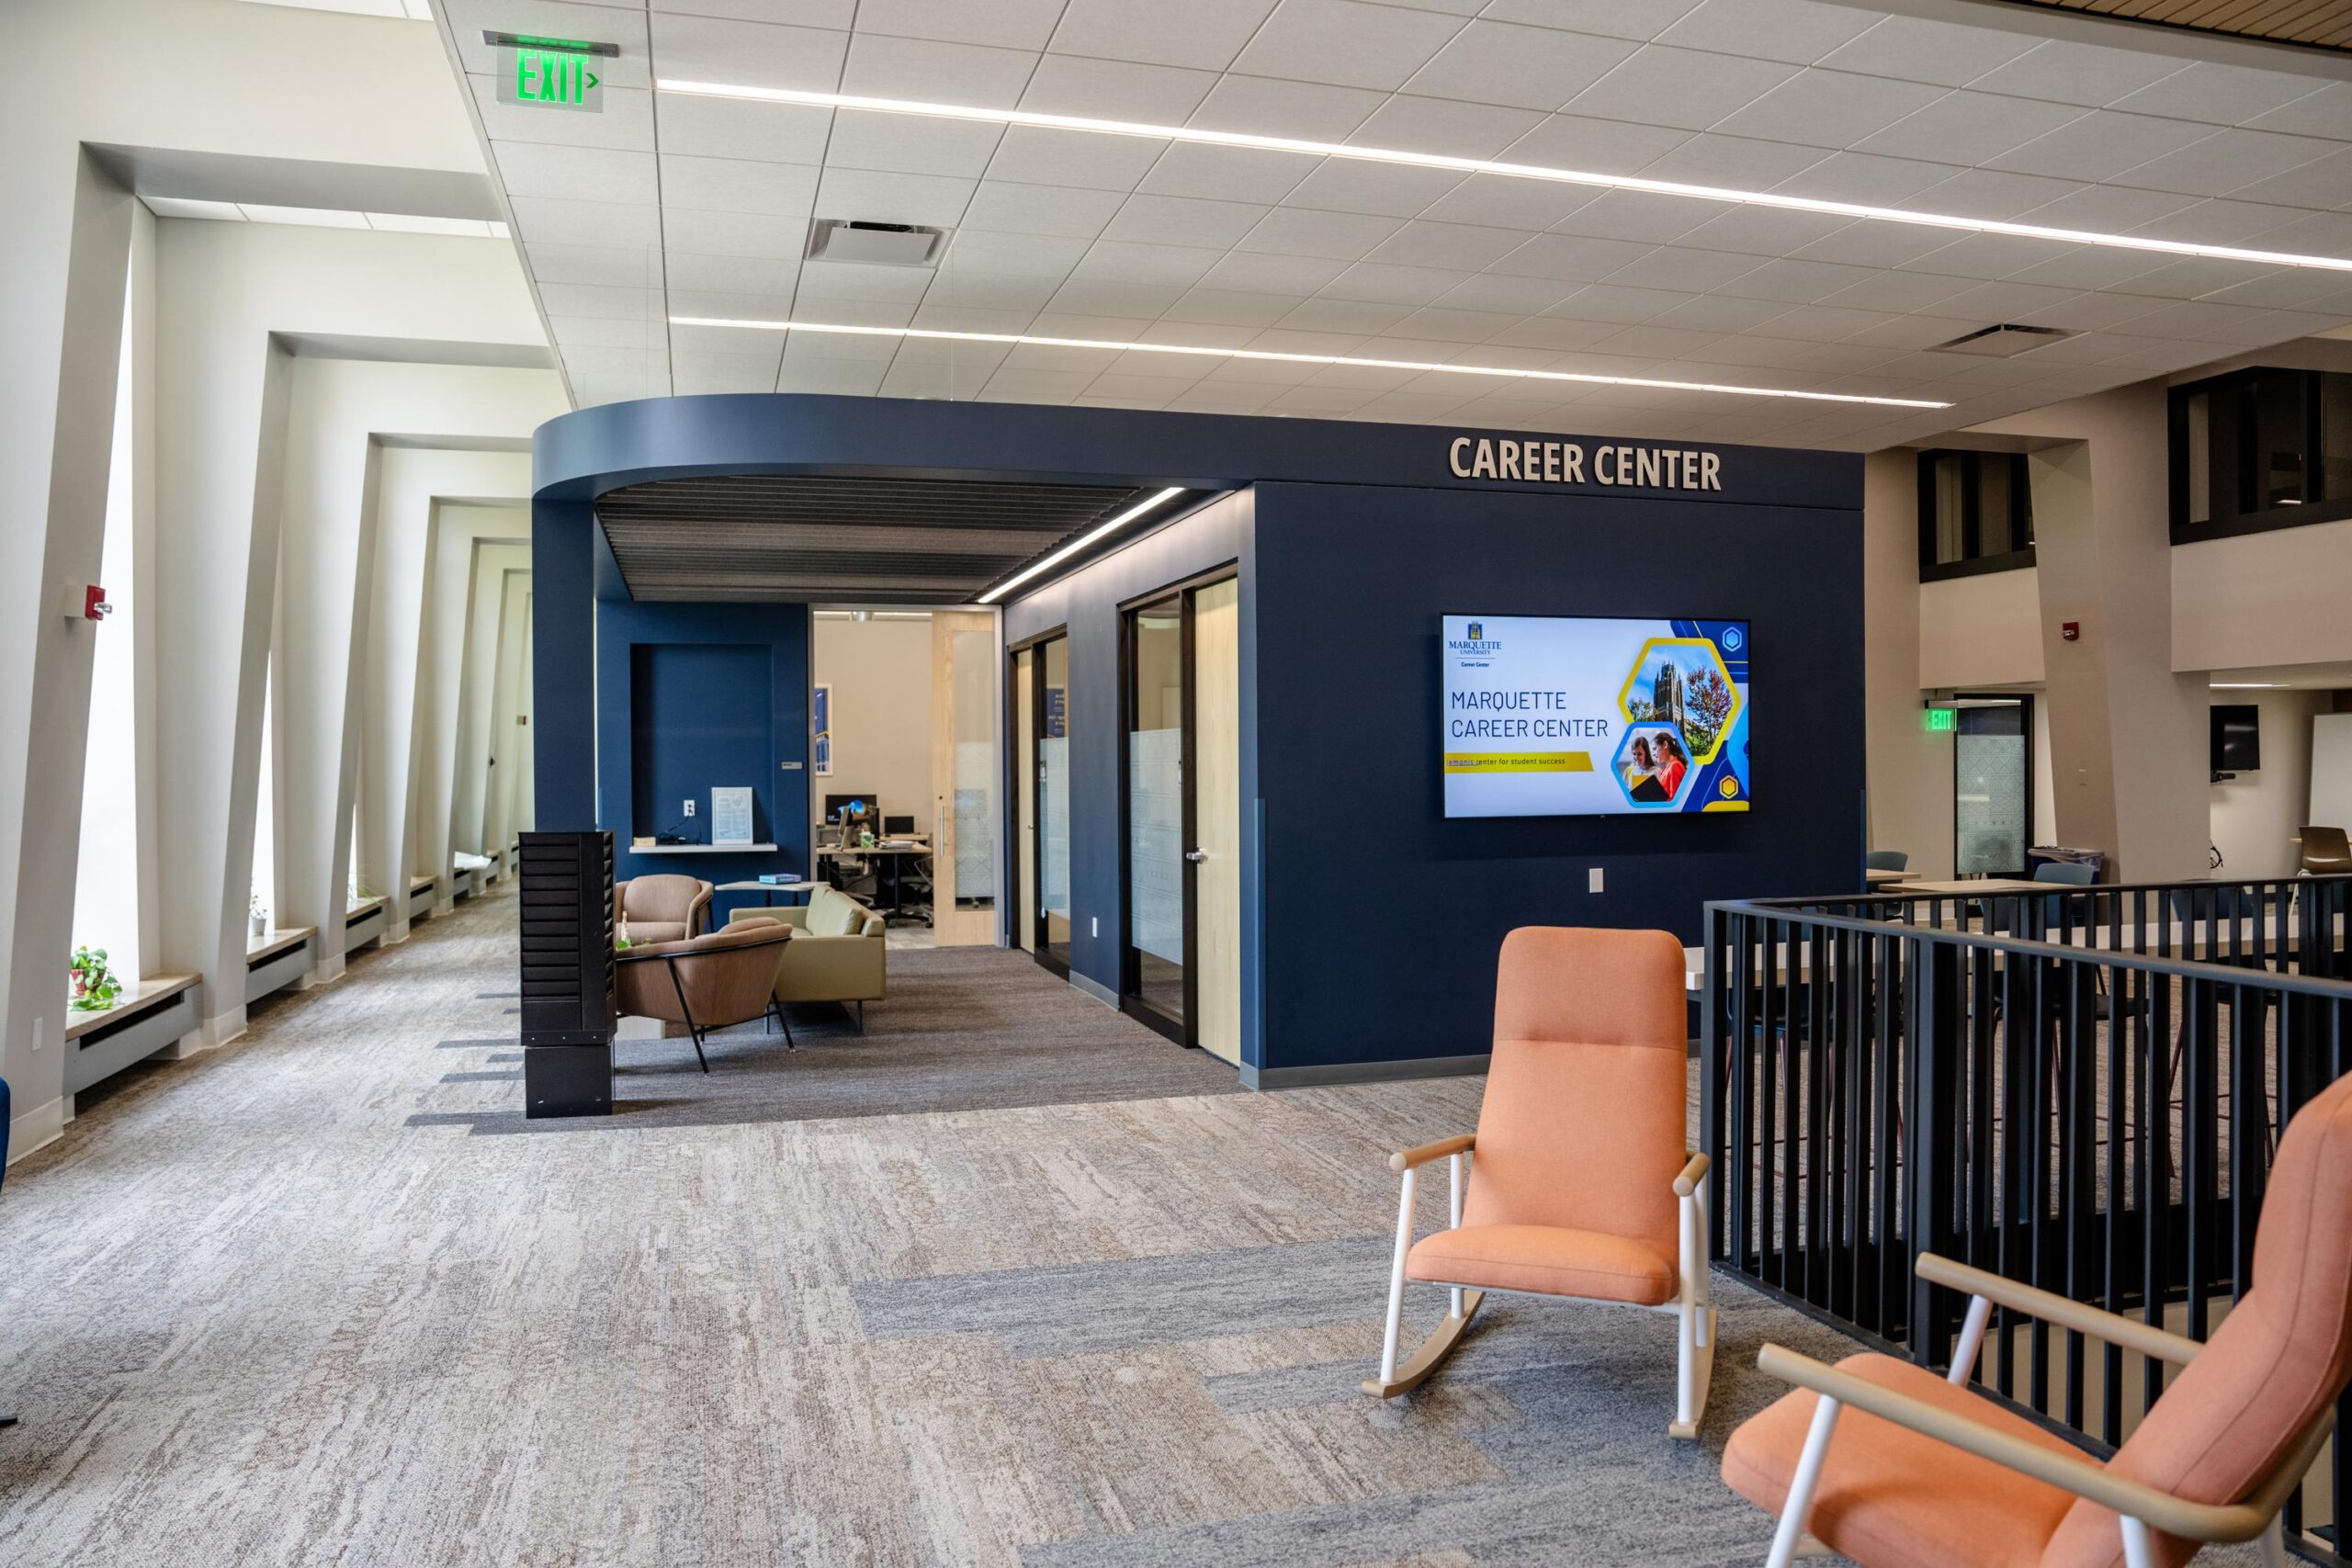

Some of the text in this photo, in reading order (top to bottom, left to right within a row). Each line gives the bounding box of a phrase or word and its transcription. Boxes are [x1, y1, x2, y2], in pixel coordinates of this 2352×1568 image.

[517, 48, 589, 106] EXIT
[1449, 436, 1722, 491] CAREER CENTER
[1449, 640, 1502, 650] MARQUETTE
[1452, 692, 1566, 712] MARQUETTE
[1452, 719, 1608, 738] CAREER CENTER
[1931, 710, 1952, 730] EXIT
[1498, 757, 1510, 765] for
[1510, 757, 1538, 765] student
[1539, 757, 1566, 765] success
